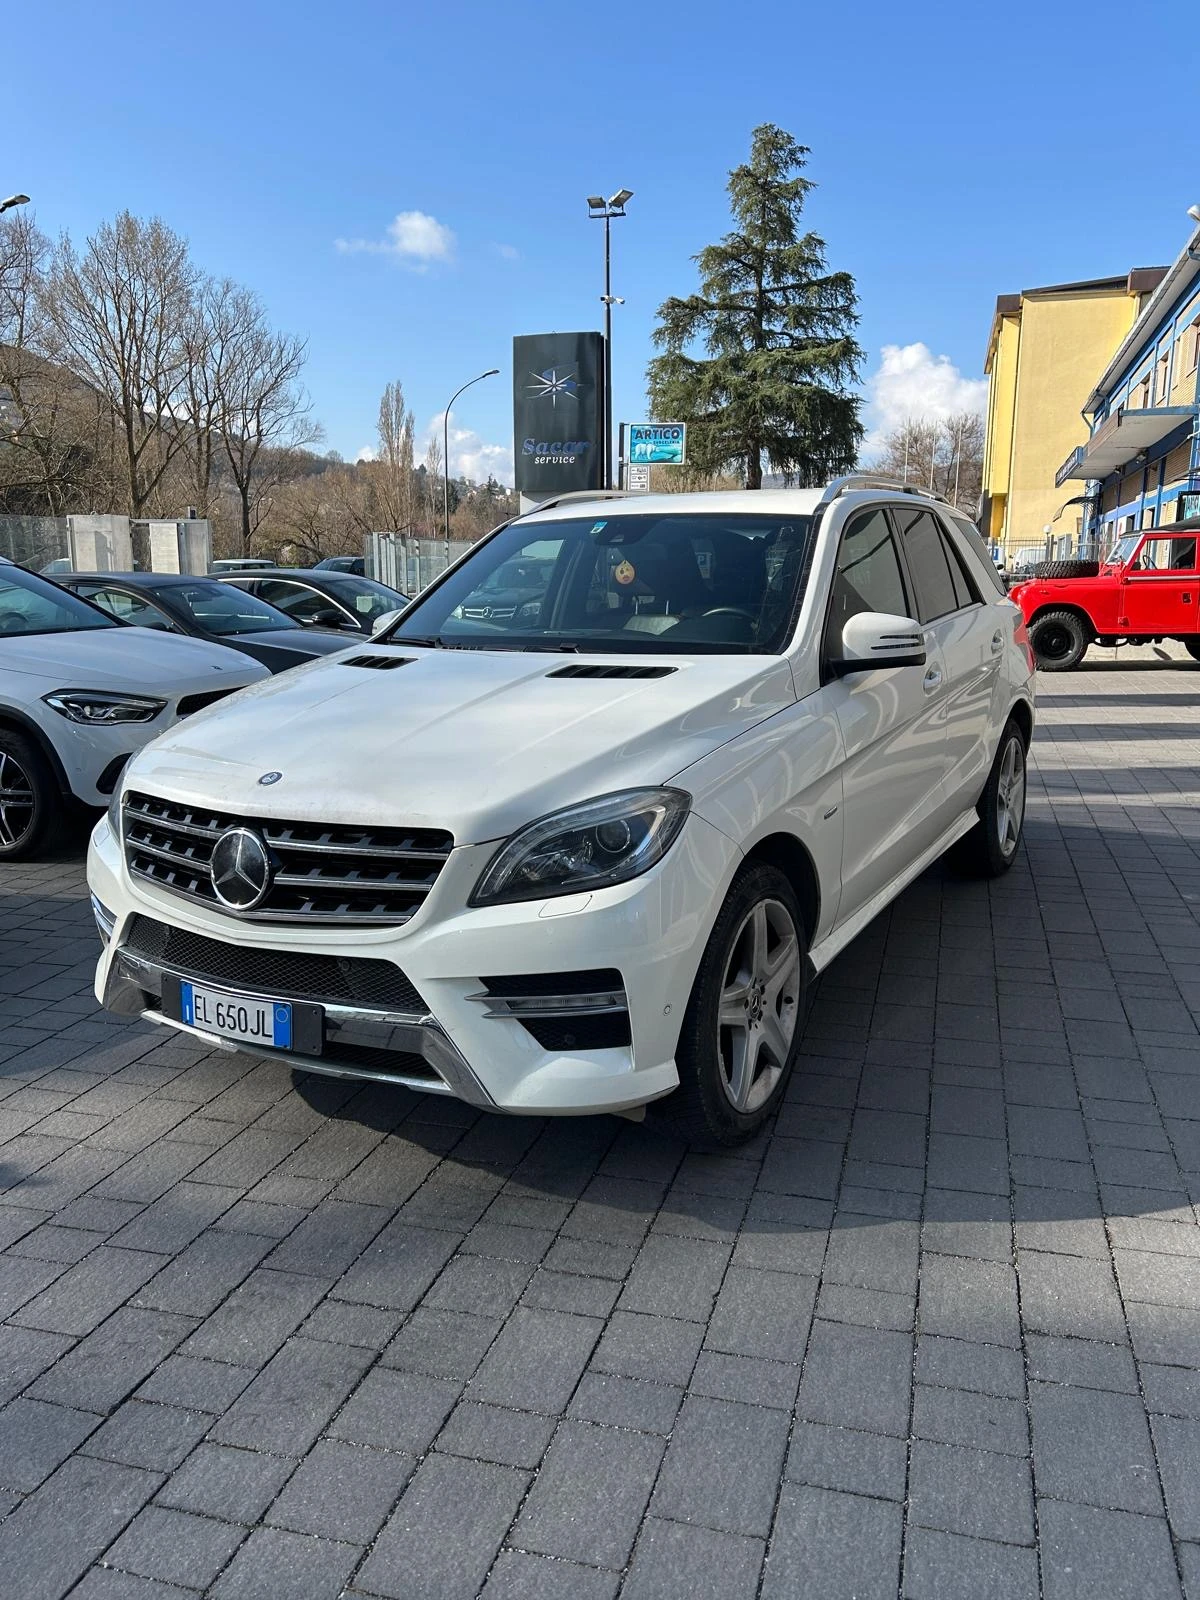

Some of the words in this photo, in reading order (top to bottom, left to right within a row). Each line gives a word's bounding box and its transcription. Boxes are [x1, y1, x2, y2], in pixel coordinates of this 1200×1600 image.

[634, 428, 680, 440] ARTICO
[522, 438, 591, 455] Sacar
[534, 456, 575, 464] service
[194, 994, 212, 1024] EL
[216, 1002, 273, 1039] 650JL
